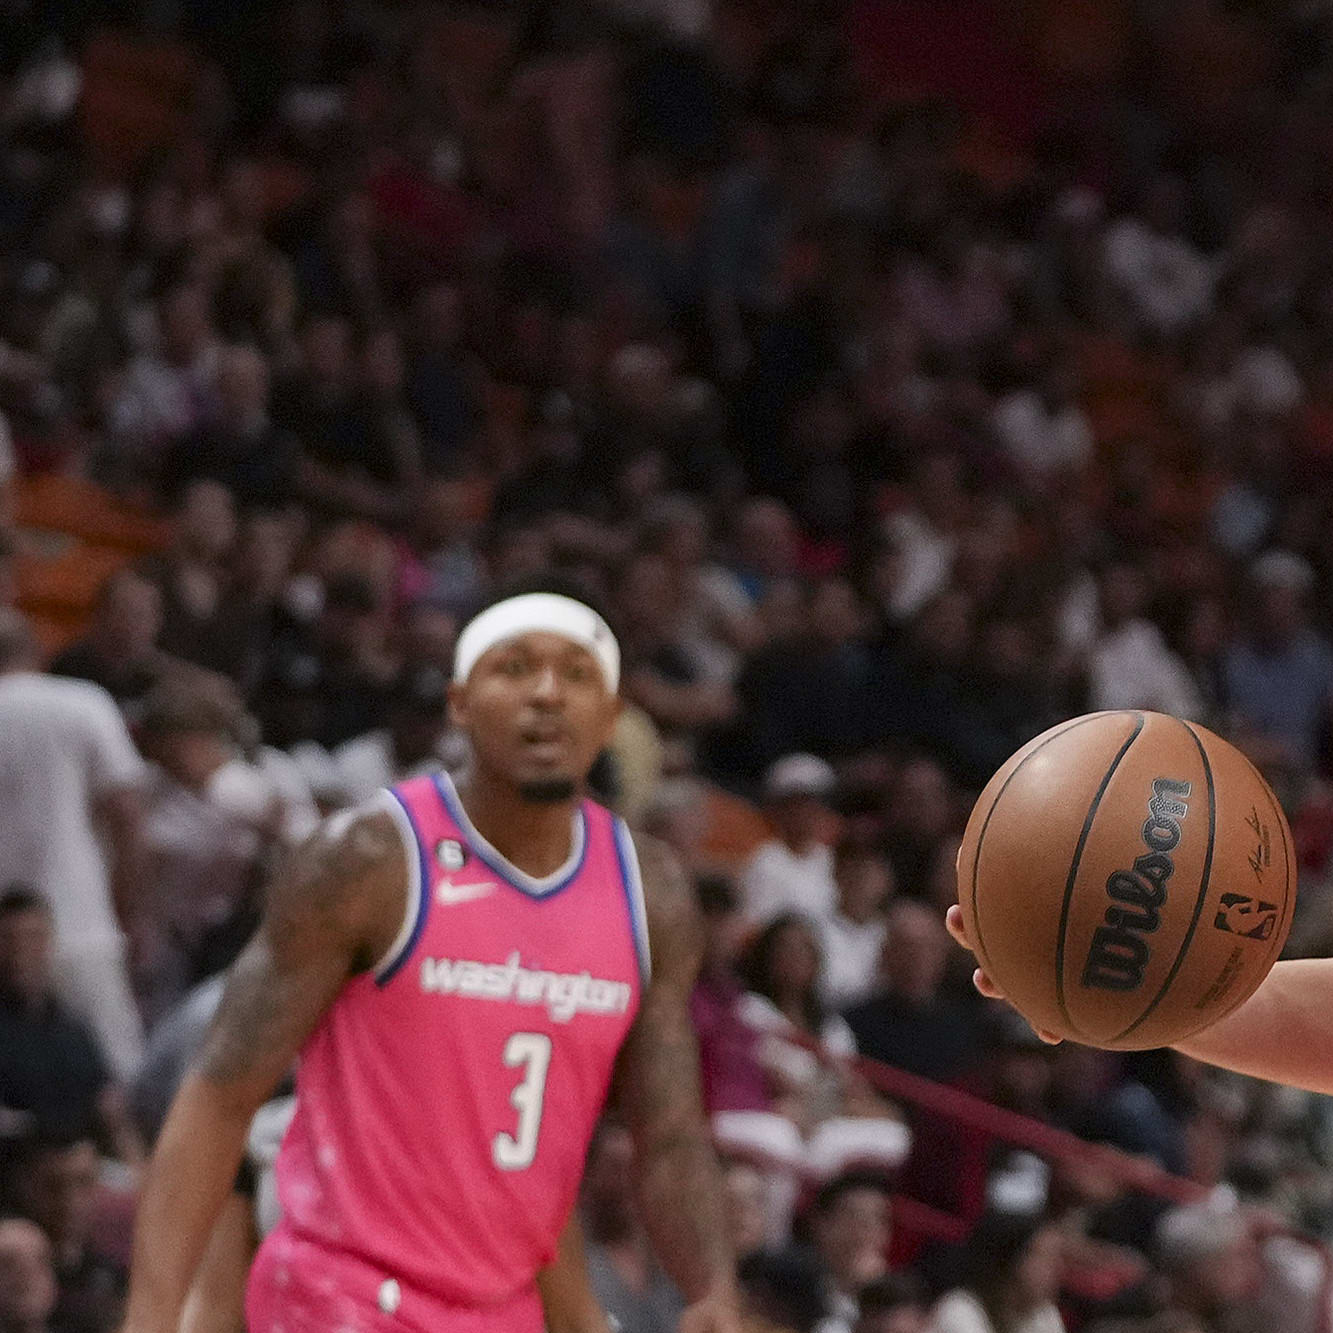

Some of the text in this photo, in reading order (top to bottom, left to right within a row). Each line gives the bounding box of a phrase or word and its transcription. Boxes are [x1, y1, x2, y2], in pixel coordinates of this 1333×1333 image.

[1081, 777, 1193, 991] Wilson
[421, 951, 631, 1022] washington
[493, 1031, 552, 1170] 3
